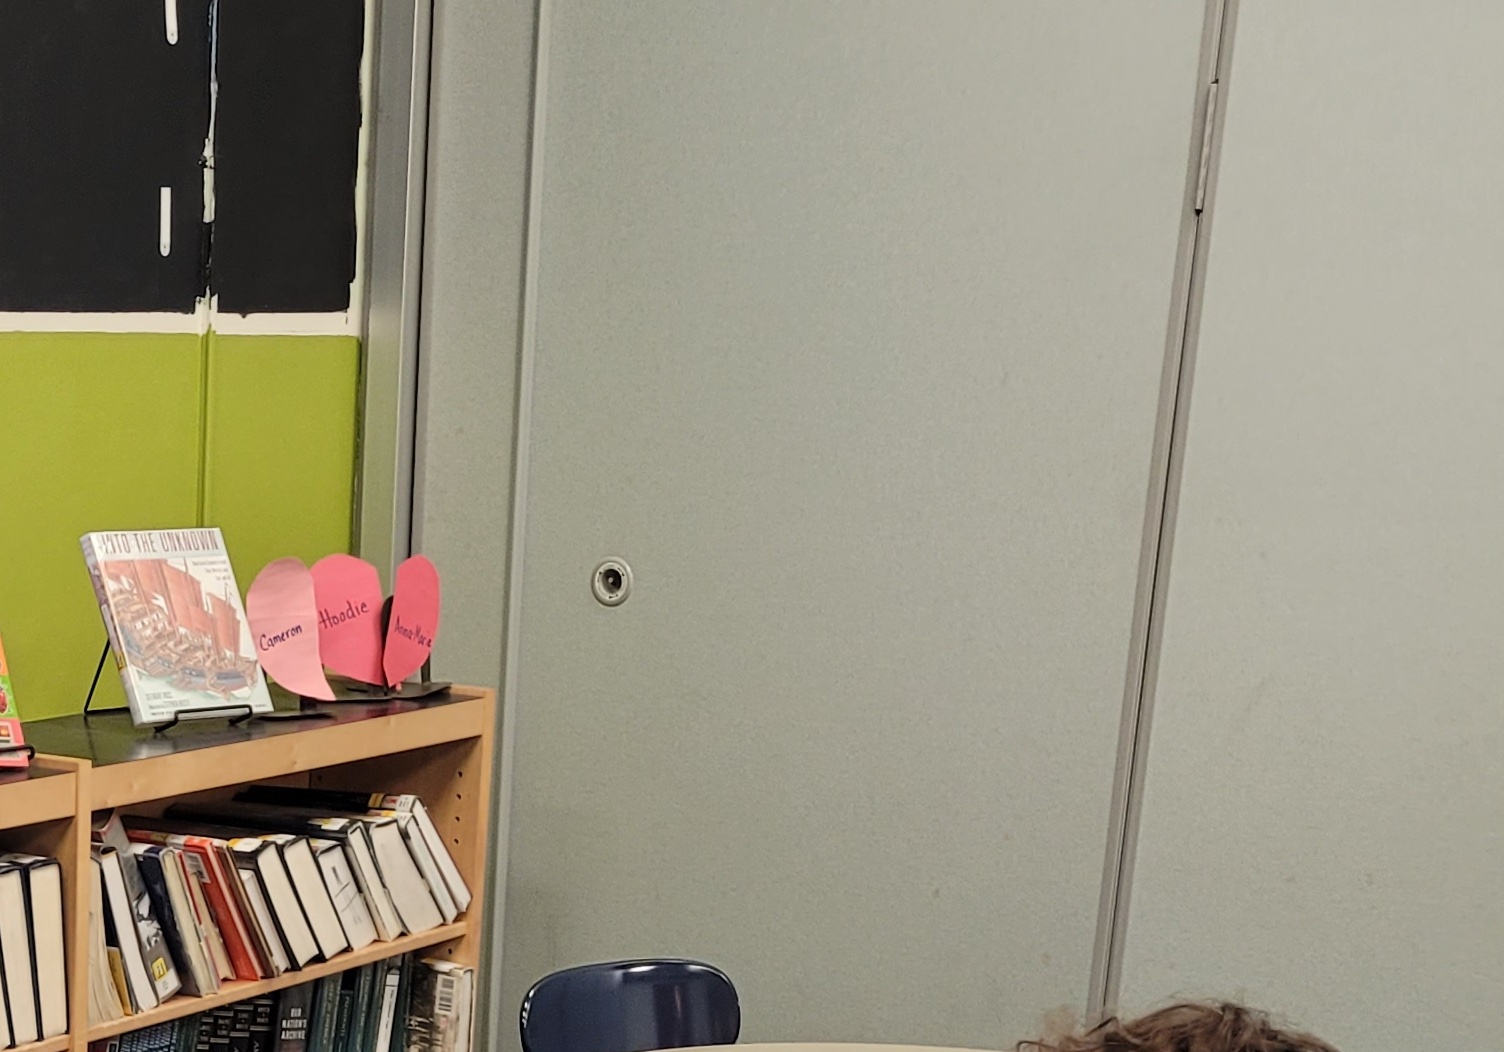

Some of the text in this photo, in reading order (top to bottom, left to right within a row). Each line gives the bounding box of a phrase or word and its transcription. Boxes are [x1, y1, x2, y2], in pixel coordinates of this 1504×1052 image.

[133, 532, 157, 552] THE
[159, 530, 219, 552] UNKNOWN
[318, 600, 370, 630] Hoodie
[259, 624, 303, 651] Cameron
